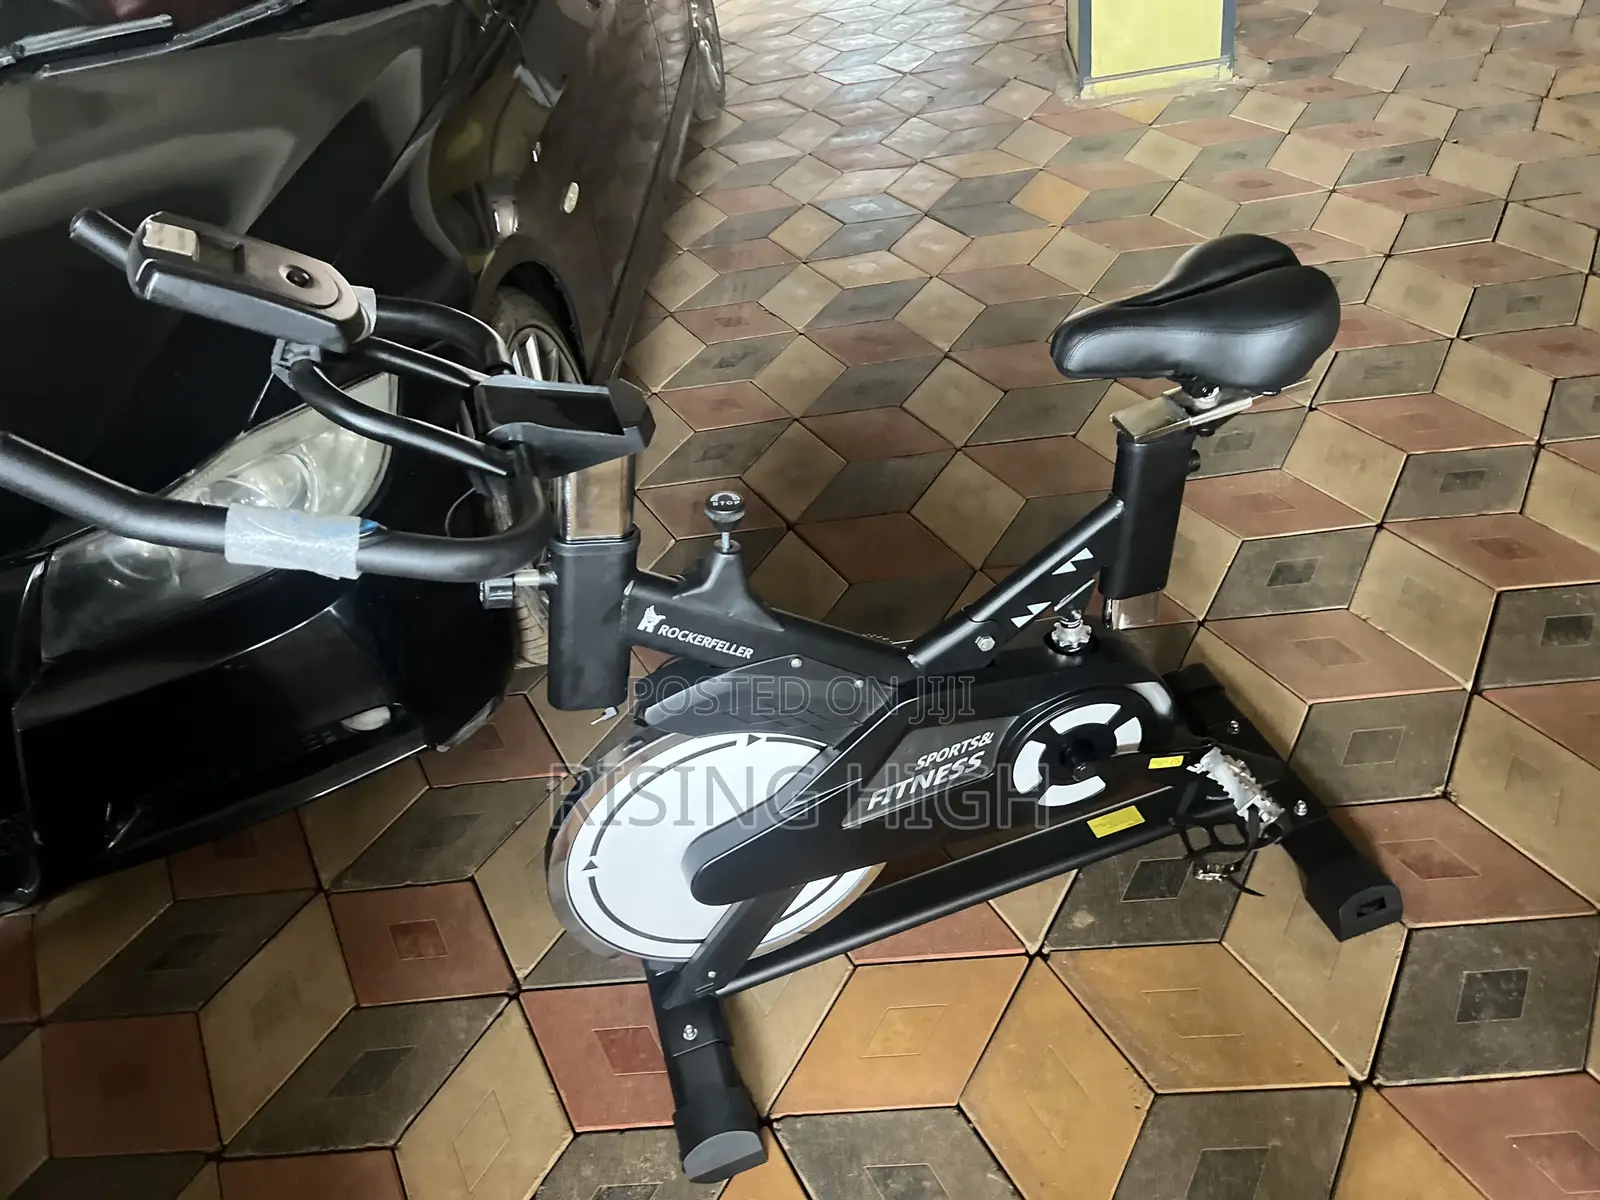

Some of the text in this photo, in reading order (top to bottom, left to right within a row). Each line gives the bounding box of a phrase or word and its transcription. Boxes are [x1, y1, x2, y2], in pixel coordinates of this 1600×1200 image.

[657, 624, 754, 659] ROCKERFELLER
[914, 731, 995, 771] SPORTS&
[866, 750, 985, 811] FITNESS
